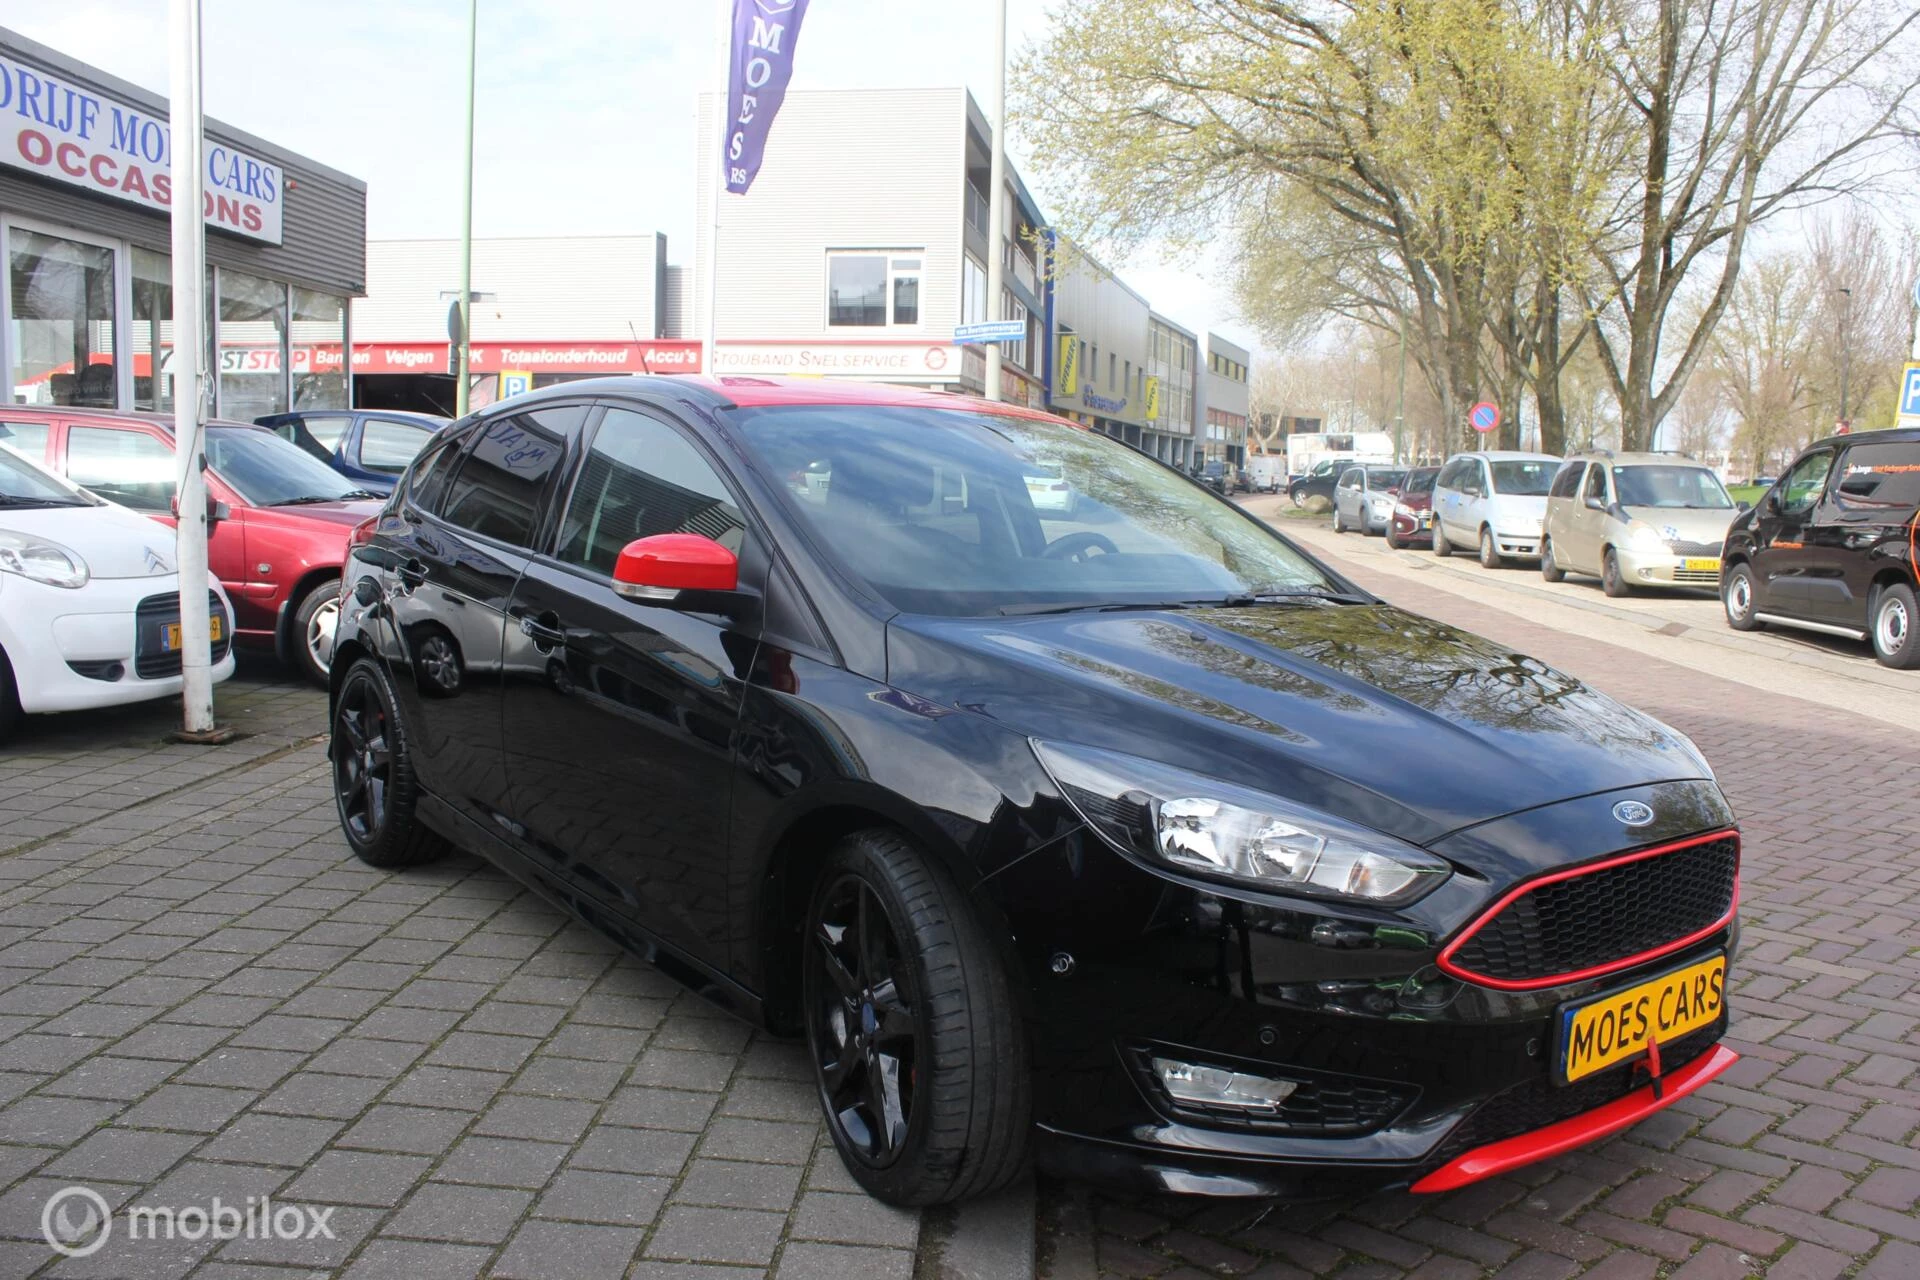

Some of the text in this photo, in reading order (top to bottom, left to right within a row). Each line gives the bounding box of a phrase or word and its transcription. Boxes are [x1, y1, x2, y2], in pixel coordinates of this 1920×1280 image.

[729, 16, 784, 160] MOES
[17, 129, 262, 232] OCCASNS
[110, 106, 171, 167] MO
[209, 147, 276, 203] CARS
[315, 351, 370, 365] Banen
[385, 350, 434, 367] Velgen
[501, 349, 628, 365] Totaalonderhoud
[644, 349, 697, 364] Accu's
[509, 377, 522, 400] P
[1618, 802, 1650, 823] Ford
[1571, 968, 1722, 1068] MOES CARS
